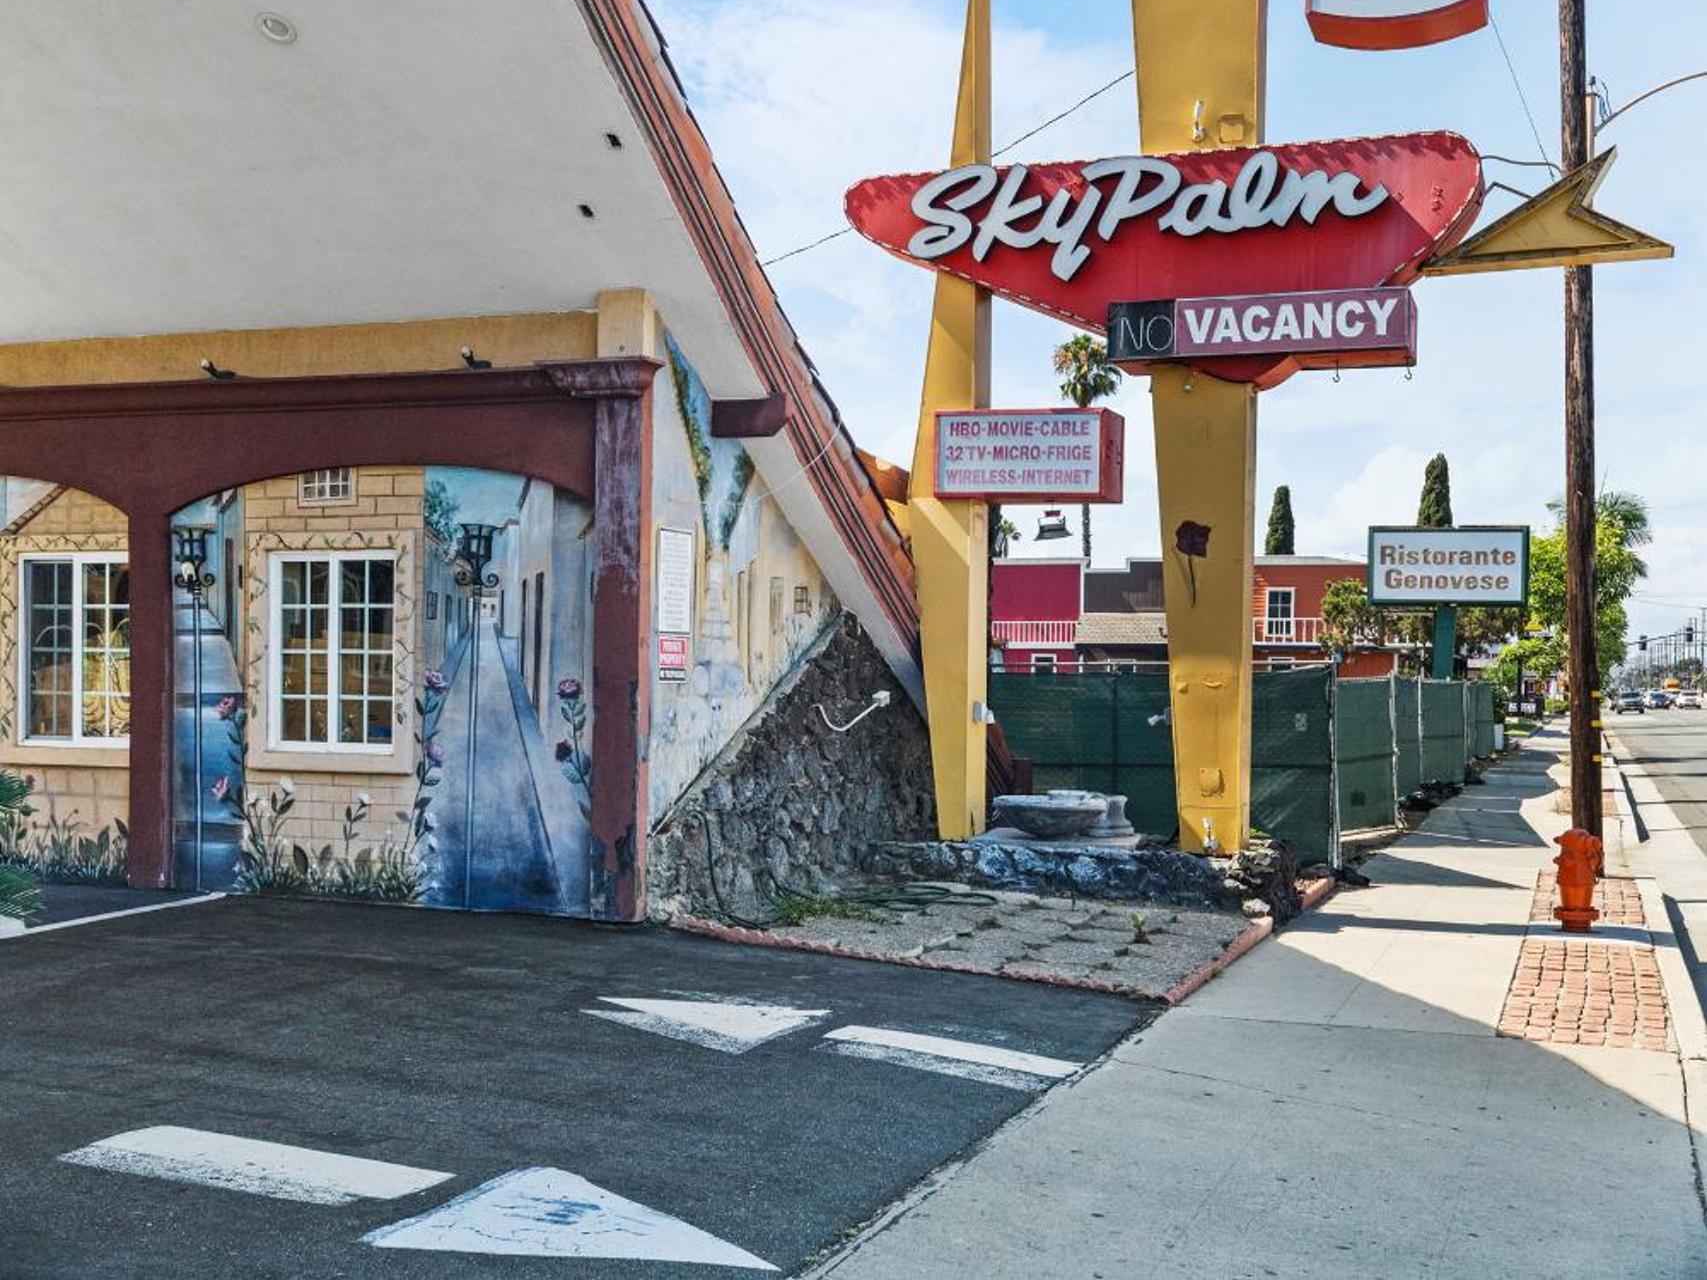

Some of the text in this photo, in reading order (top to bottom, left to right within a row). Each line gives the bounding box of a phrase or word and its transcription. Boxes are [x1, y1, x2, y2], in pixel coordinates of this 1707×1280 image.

[1118, 298, 1398, 352] NO VACANCY
[1380, 545, 1516, 565] Ristorante
[1385, 569, 1509, 590] Genovese
